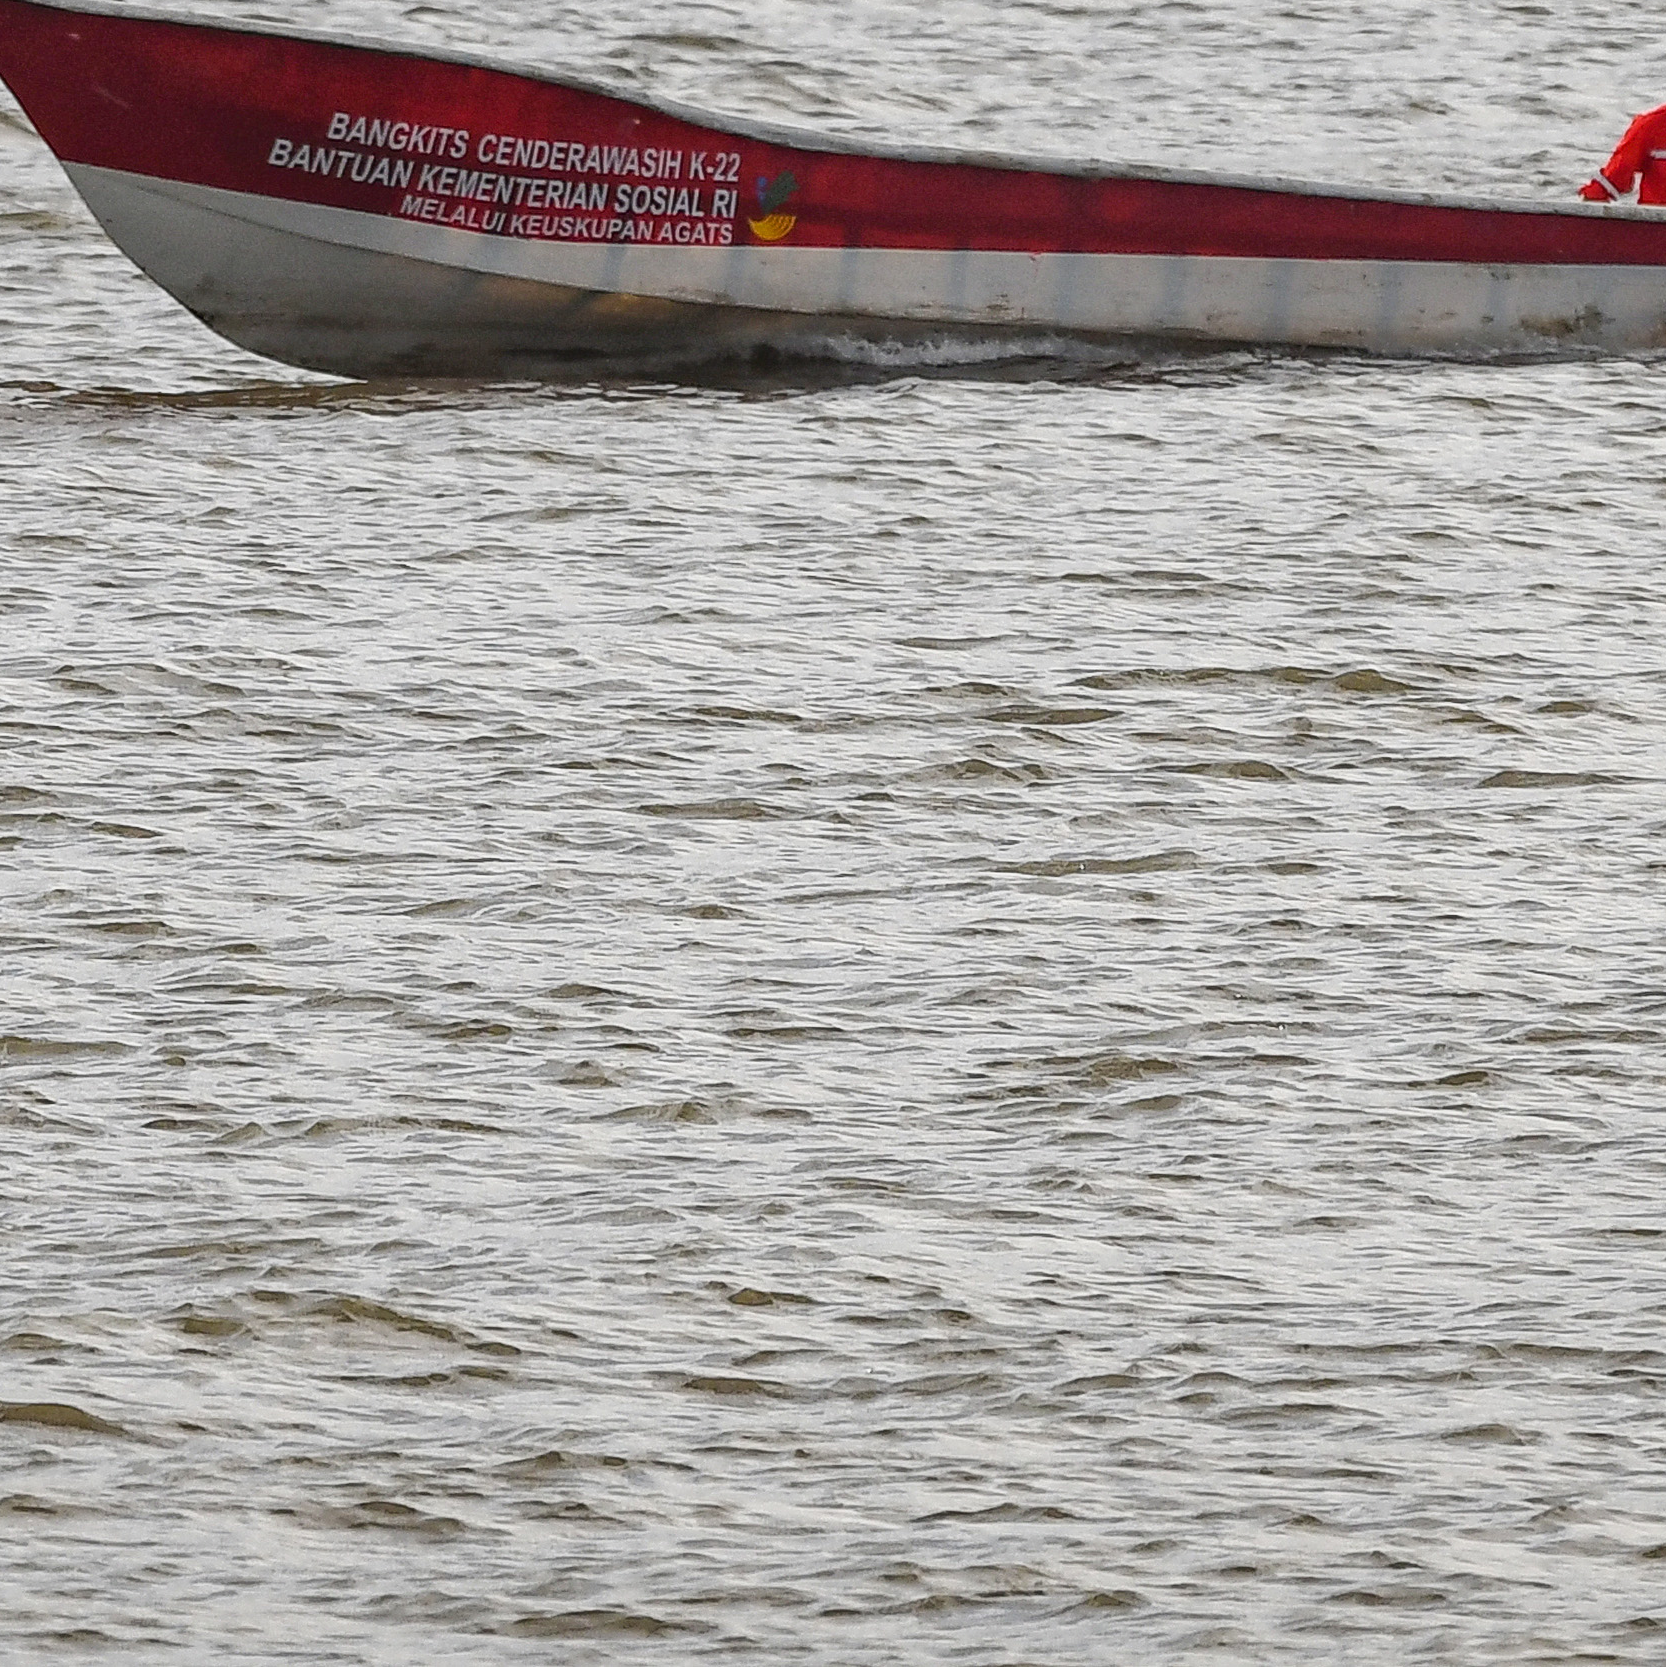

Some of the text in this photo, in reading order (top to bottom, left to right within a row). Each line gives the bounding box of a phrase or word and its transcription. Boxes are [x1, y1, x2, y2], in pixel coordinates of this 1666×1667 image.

[268, 138, 738, 218] BANTUAN KEMENTERIAN SOSIAL RI
[327, 112, 741, 182] BANGKITS CENDERAWASIH K-22
[400, 195, 733, 245] MELALUI KEUSKUPAN AGATS
